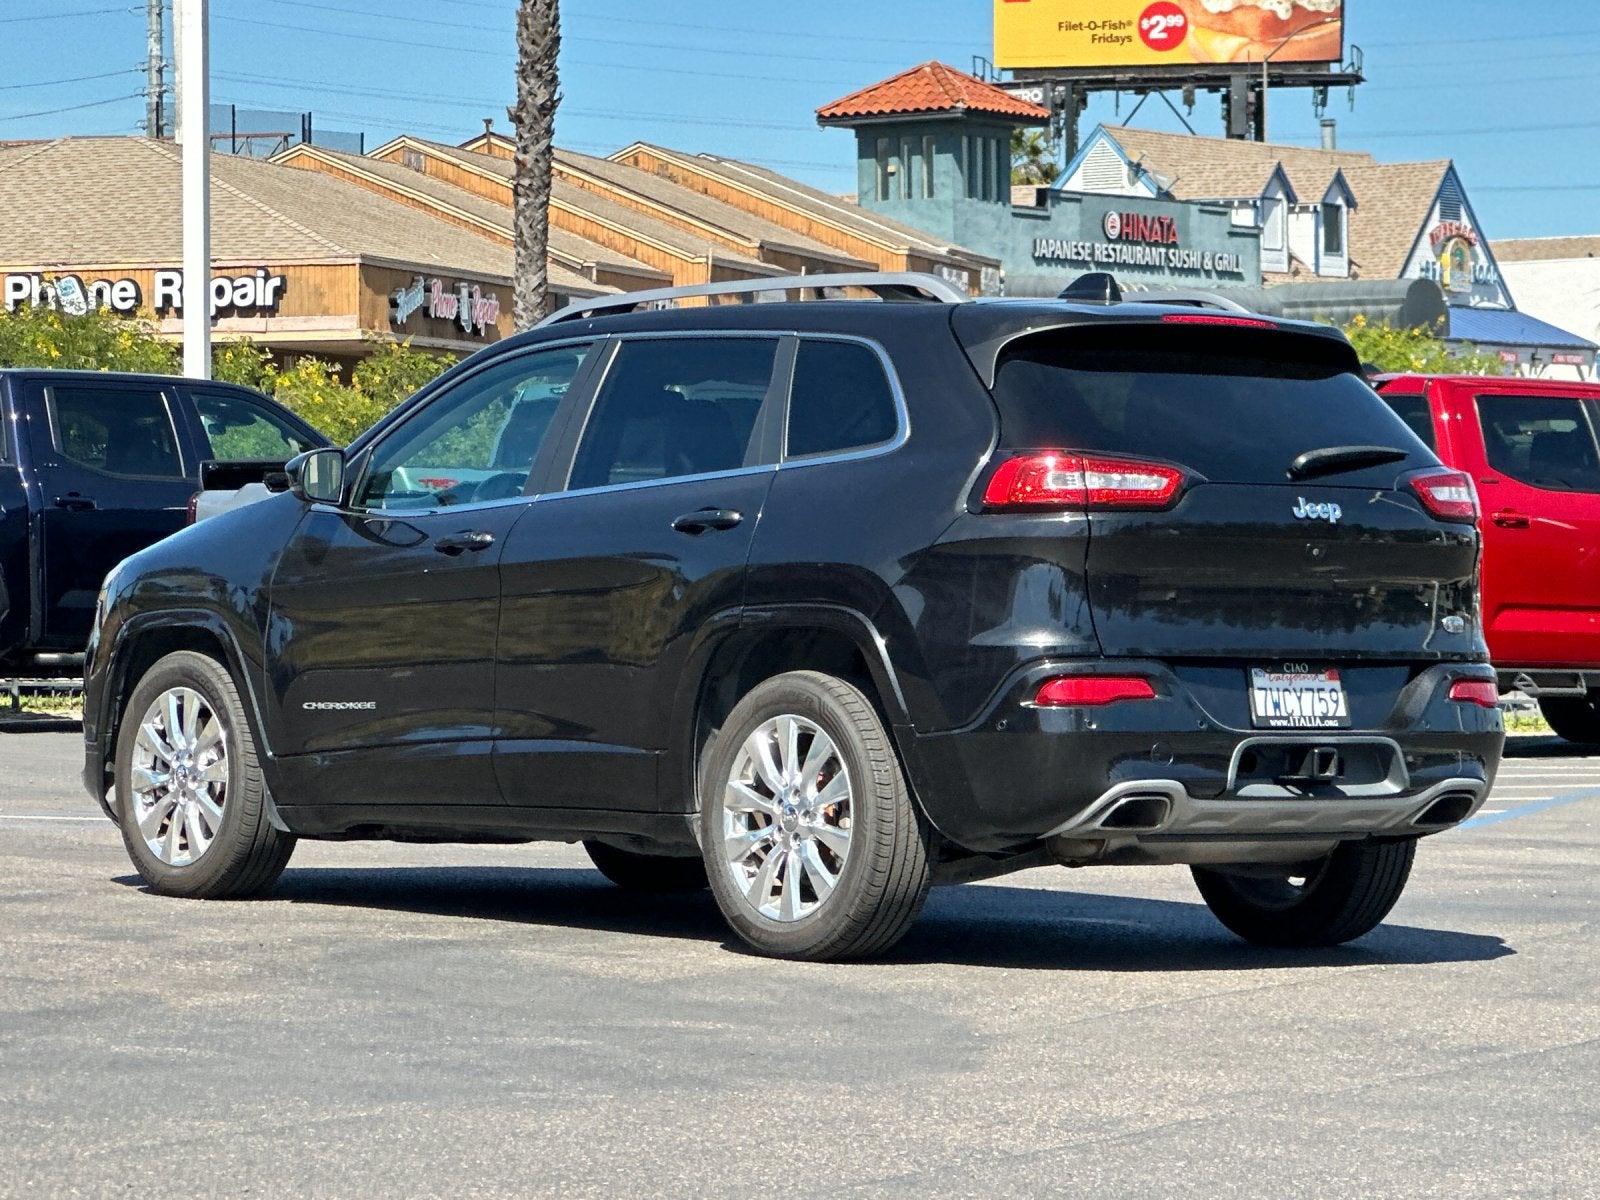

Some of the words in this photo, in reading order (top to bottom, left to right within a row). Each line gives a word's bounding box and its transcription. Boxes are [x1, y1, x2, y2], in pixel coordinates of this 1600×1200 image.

[1091, 33, 1132, 45] Fridays
[1120, 212, 1179, 243] HINATA
[1034, 239, 1092, 261] JAPANESE
[1094, 243, 1167, 266] RESTAURANT
[1168, 248, 1201, 269] SUSHI
[1202, 252, 1213, 270] &
[1214, 253, 1245, 273] GRILL
[154, 269, 281, 316] Rpair
[430, 278, 458, 320] Phone
[1292, 497, 1343, 523] Jeep
[1283, 662, 1309, 673] CIAO
[302, 701, 377, 710] CHEROKEE
[1257, 687, 1340, 717] 7WCY759
